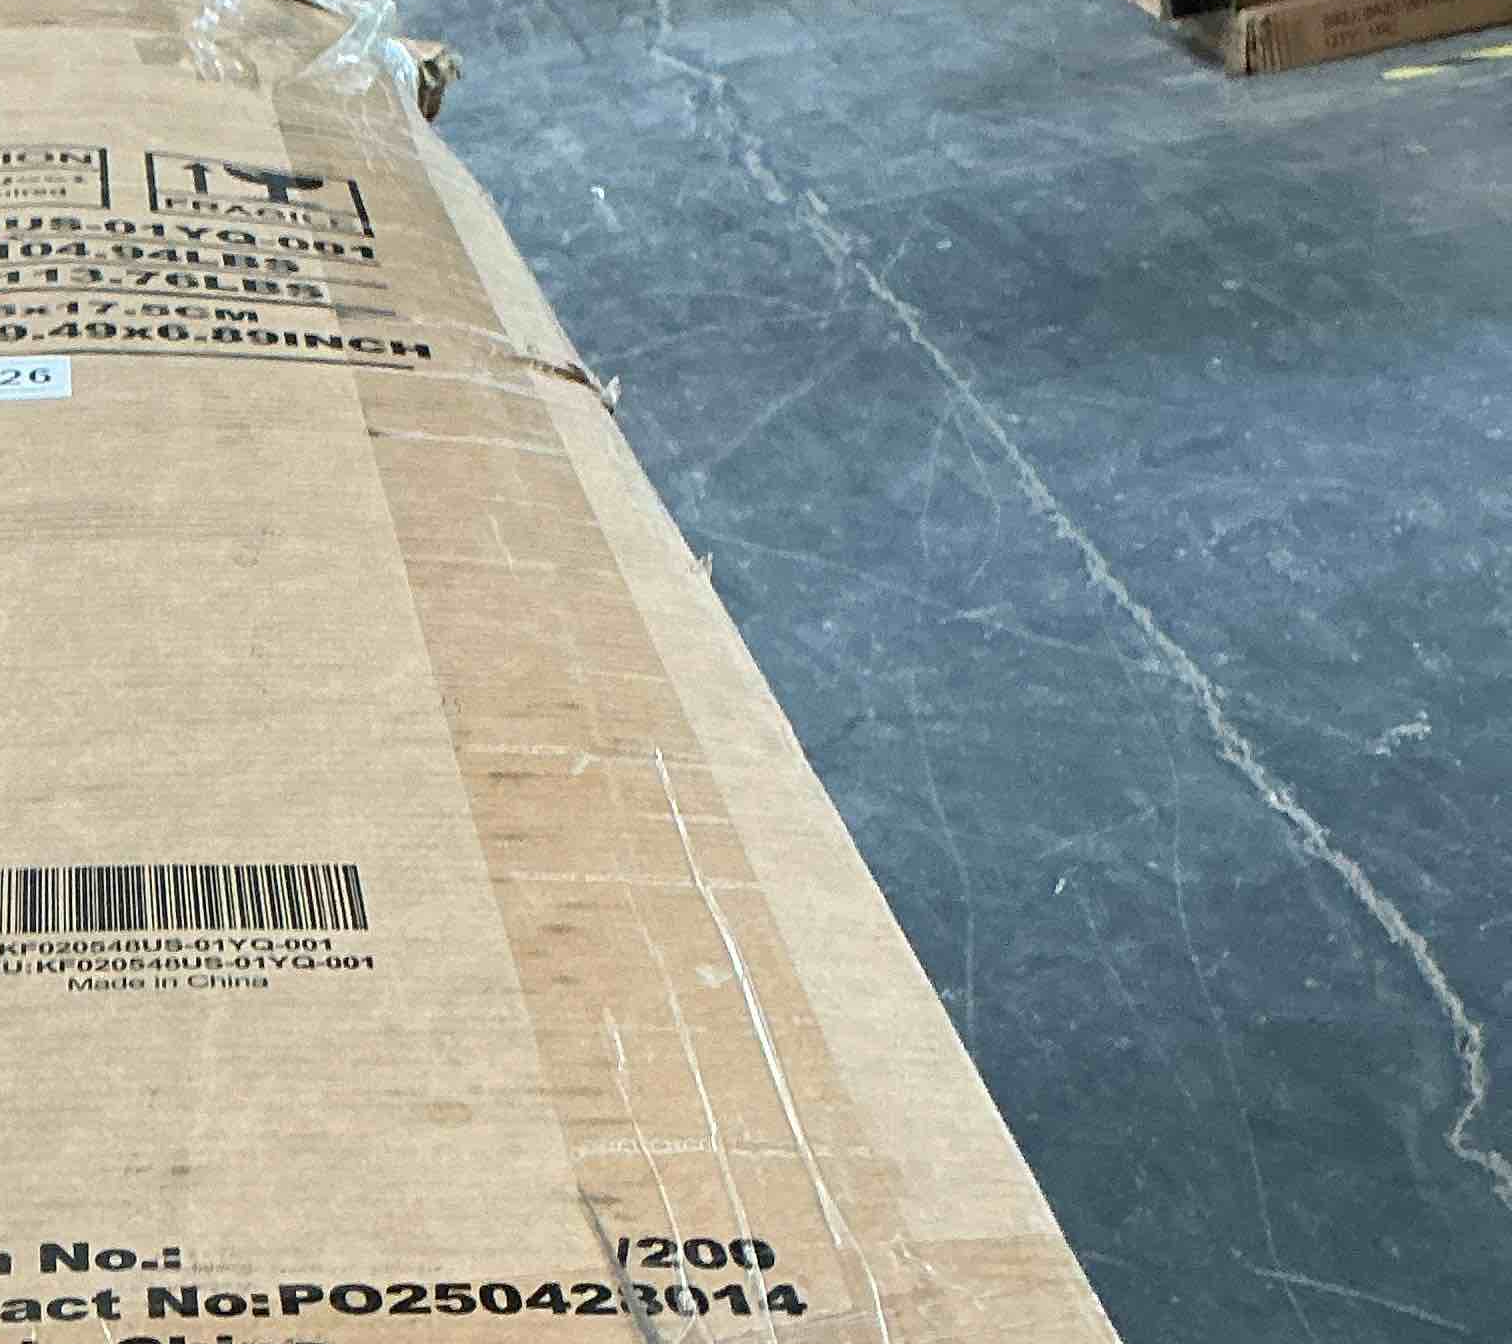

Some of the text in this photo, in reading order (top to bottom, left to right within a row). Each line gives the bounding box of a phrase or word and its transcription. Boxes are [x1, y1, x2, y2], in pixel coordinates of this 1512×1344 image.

[68, 973, 269, 993] Made in China
[39, 1241, 181, 1274] No.:
